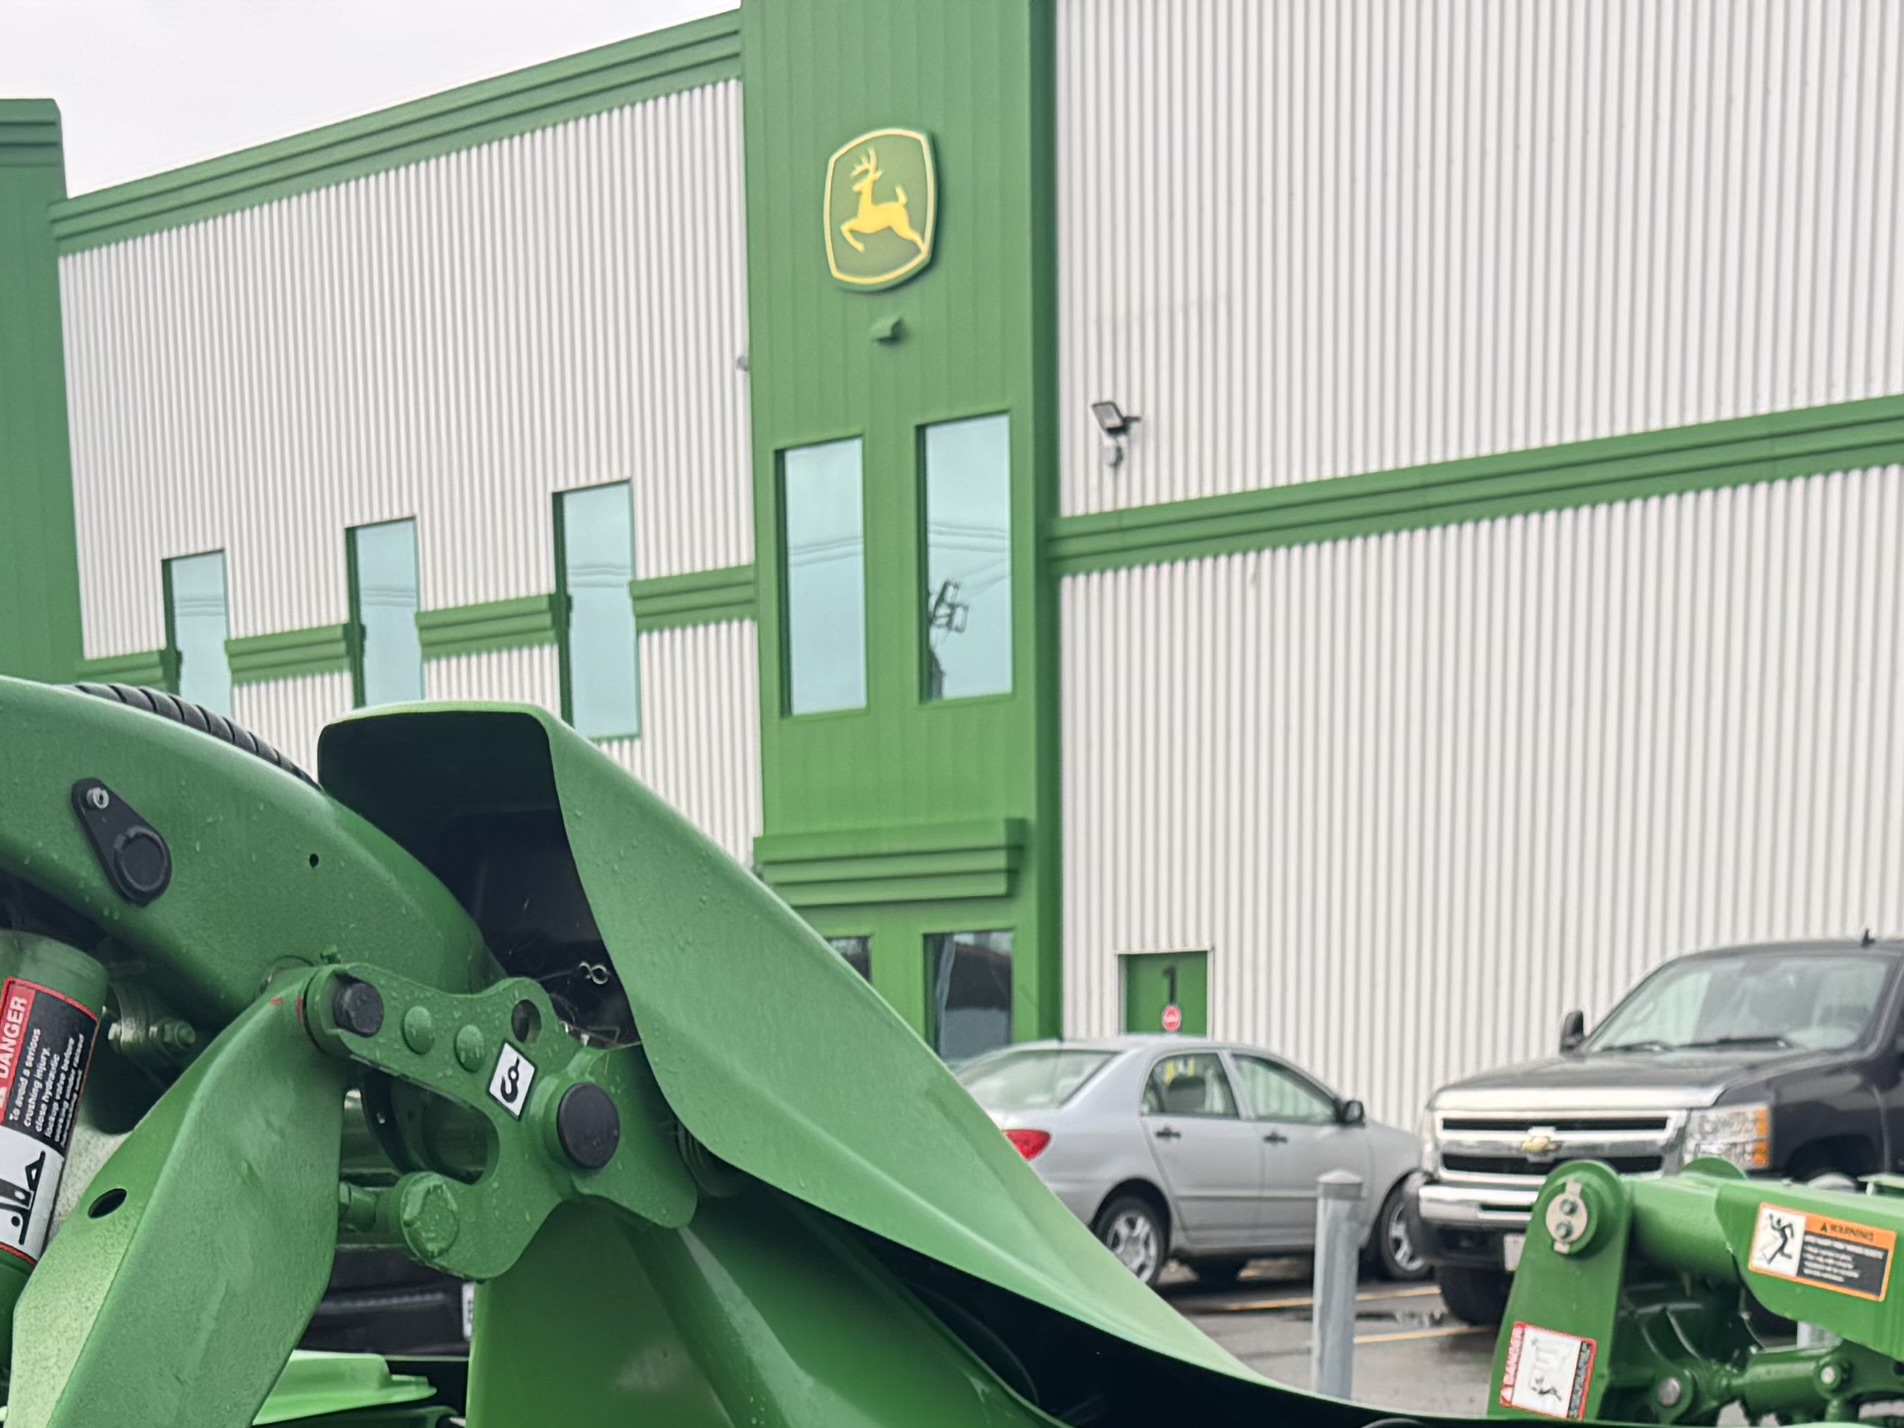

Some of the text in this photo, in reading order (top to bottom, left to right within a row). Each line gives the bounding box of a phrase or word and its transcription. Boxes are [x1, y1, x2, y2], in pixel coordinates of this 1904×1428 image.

[1162, 965, 1178, 1005] 1
[9, 1110, 20, 1121] To
[15, 1077, 28, 1108] avoid
[26, 1028, 41, 1067] serious
[35, 1053, 60, 1132] close hydraulic
[55, 1072, 66, 1100] valve
[61, 1037, 74, 1071] before
[24, 1080, 43, 1127] crushing
[1830, 1223, 1874, 1242] WARNING
